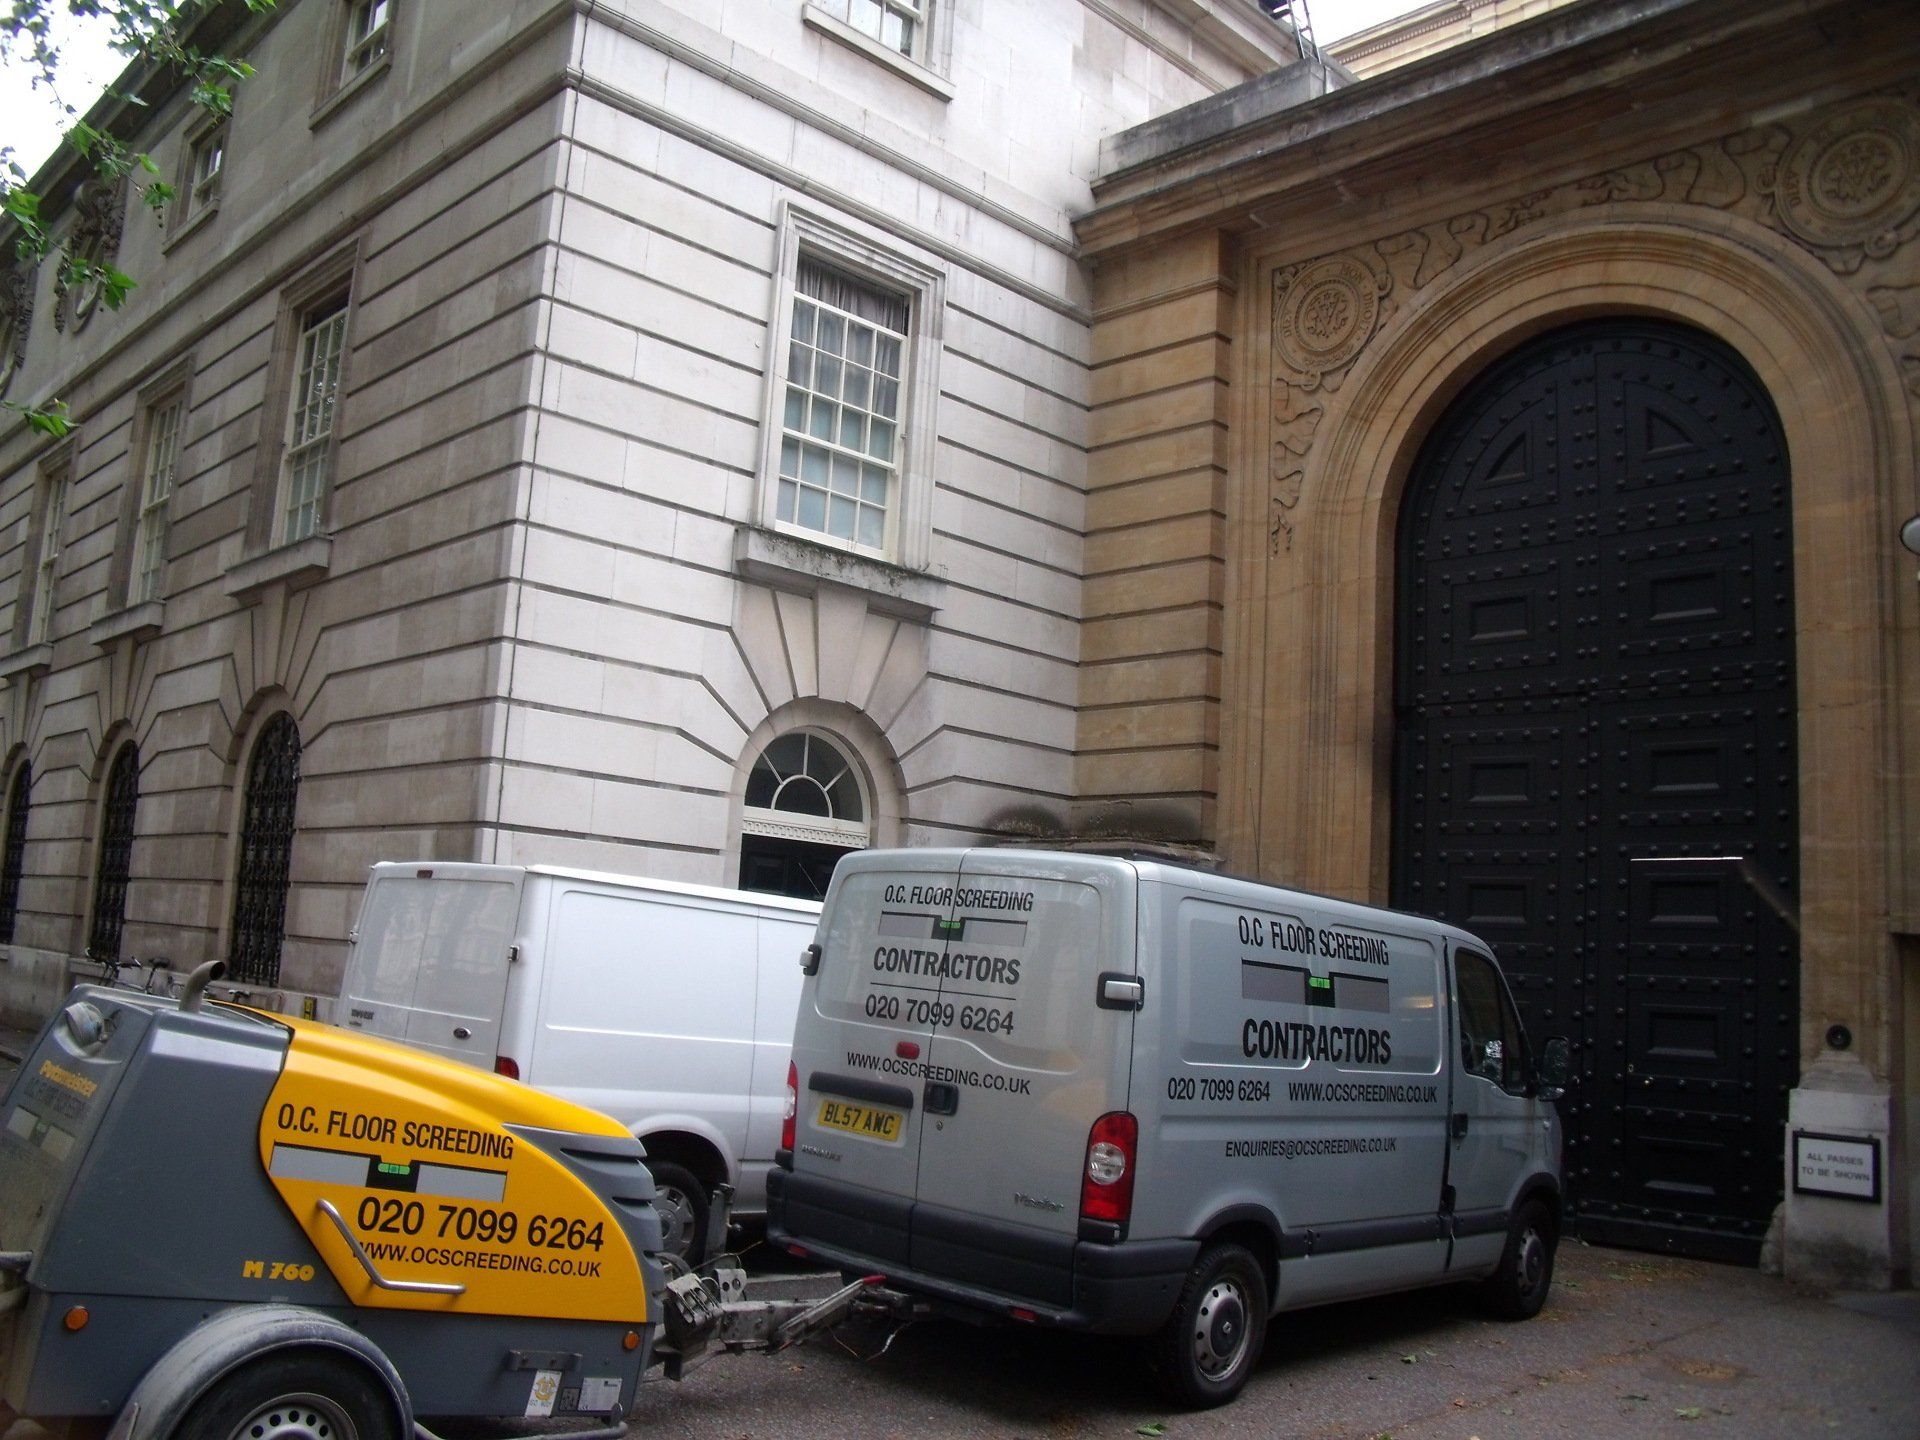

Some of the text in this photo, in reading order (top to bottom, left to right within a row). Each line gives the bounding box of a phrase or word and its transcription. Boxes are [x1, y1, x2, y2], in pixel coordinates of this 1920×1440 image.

[884, 885, 1034, 912] O.C. FLOOR SCREEDING
[1238, 915, 1389, 966] O.C FLOOR SCREEDING
[873, 946, 1021, 986] CONTRACTORS
[865, 994, 1014, 1035] 020 7099 6264
[1243, 1018, 1392, 1065] CONTRACTORS
[847, 1052, 1031, 1095] WWW.OCSCREEDING.CO.UK
[1168, 1077, 1270, 1101] 020 7099 6264
[1288, 1082, 1438, 1103] WWW.OCSCREEDING.CO.UK
[277, 1103, 514, 1160] O.C. FLOOR SCREEDING
[824, 1103, 895, 1135] BL57 AWC
[1225, 1137, 1397, 1159] ENQUIRIES@OCSCREEDING.CO.UK
[1807, 1152, 1864, 1166] ALL PASSES
[1802, 1166, 1870, 1181] TO BE SHOWN
[357, 1196, 604, 1252] 020 7099 6264
[243, 1260, 315, 1281] M 760
